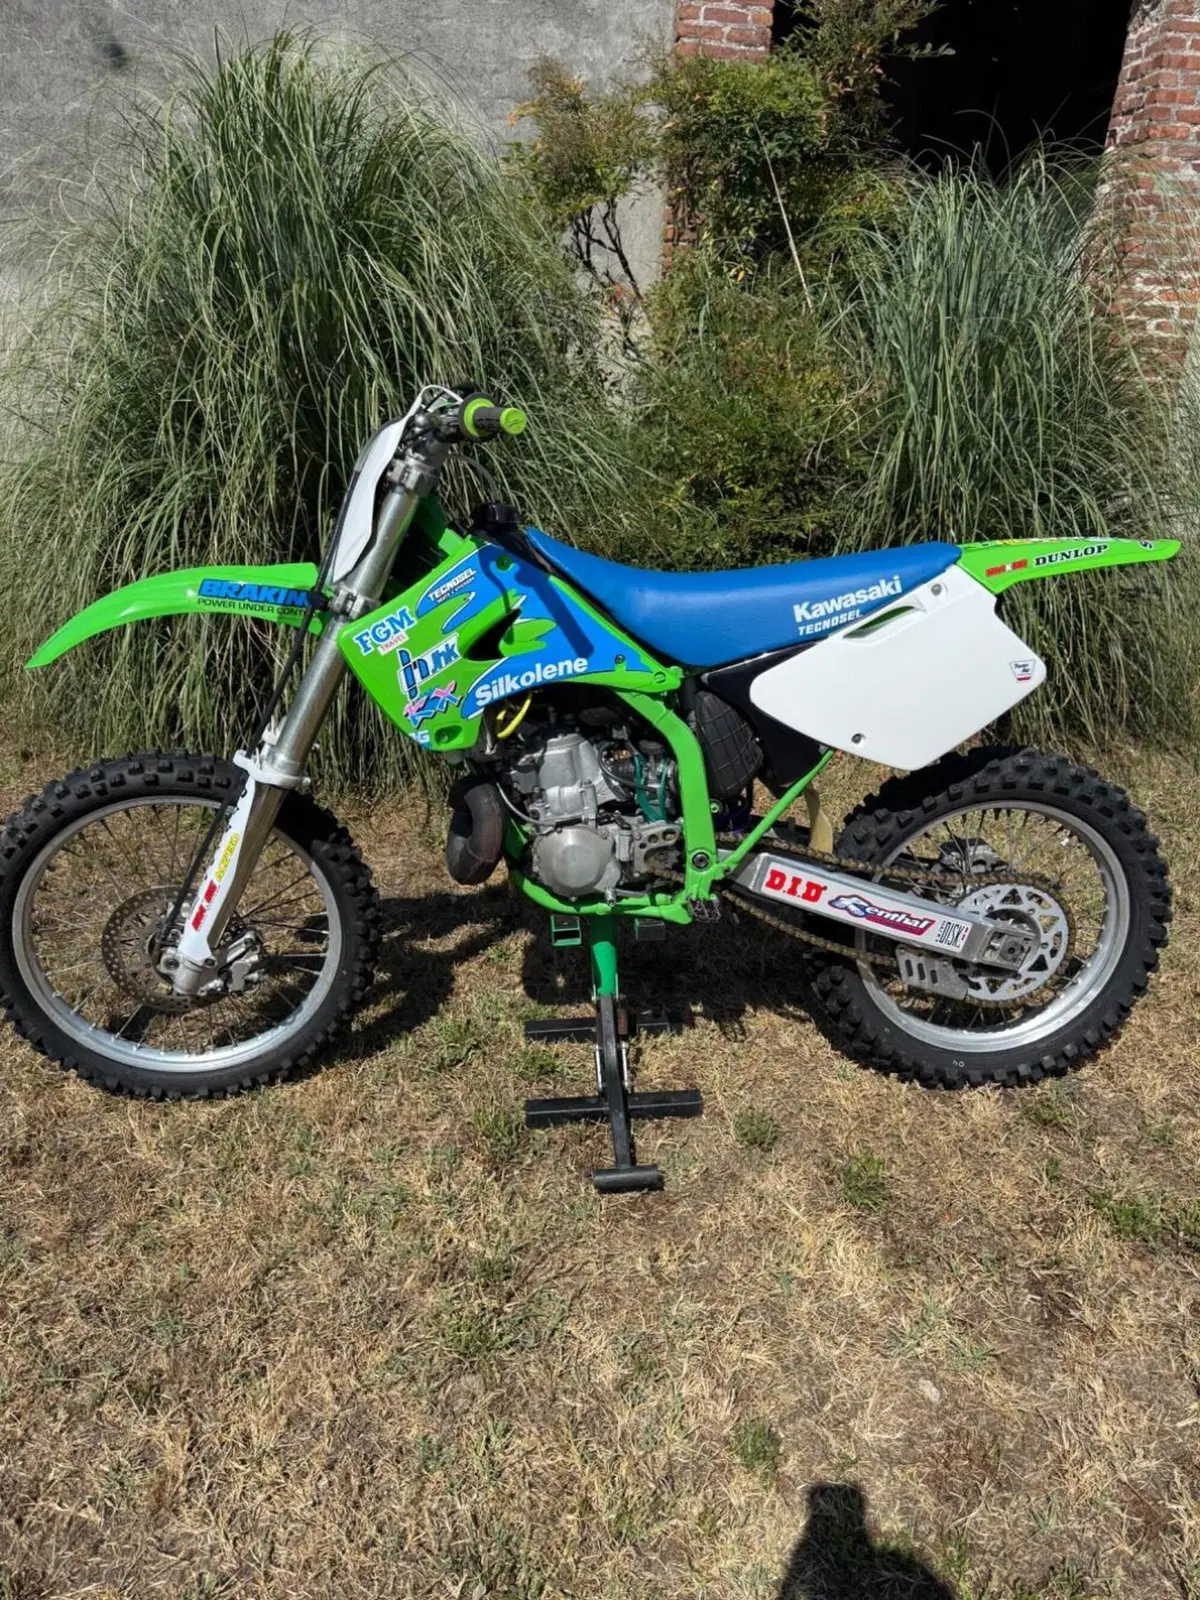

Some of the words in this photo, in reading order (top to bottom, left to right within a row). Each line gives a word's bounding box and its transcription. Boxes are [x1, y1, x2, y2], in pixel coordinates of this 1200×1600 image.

[1034, 544, 1108, 567] DUNLOP
[199, 578, 309, 608] BRAKIN
[428, 568, 477, 600] TECNOSEL
[793, 575, 903, 622] Kawasaki
[198, 598, 236, 610] POWER
[238, 603, 275, 614] UNDER
[276, 606, 309, 617] CONT
[798, 608, 863, 636] TECNOSEL
[355, 607, 416, 653] FGM
[475, 656, 588, 707] Silkolene
[829, 895, 934, 934] Renthal
